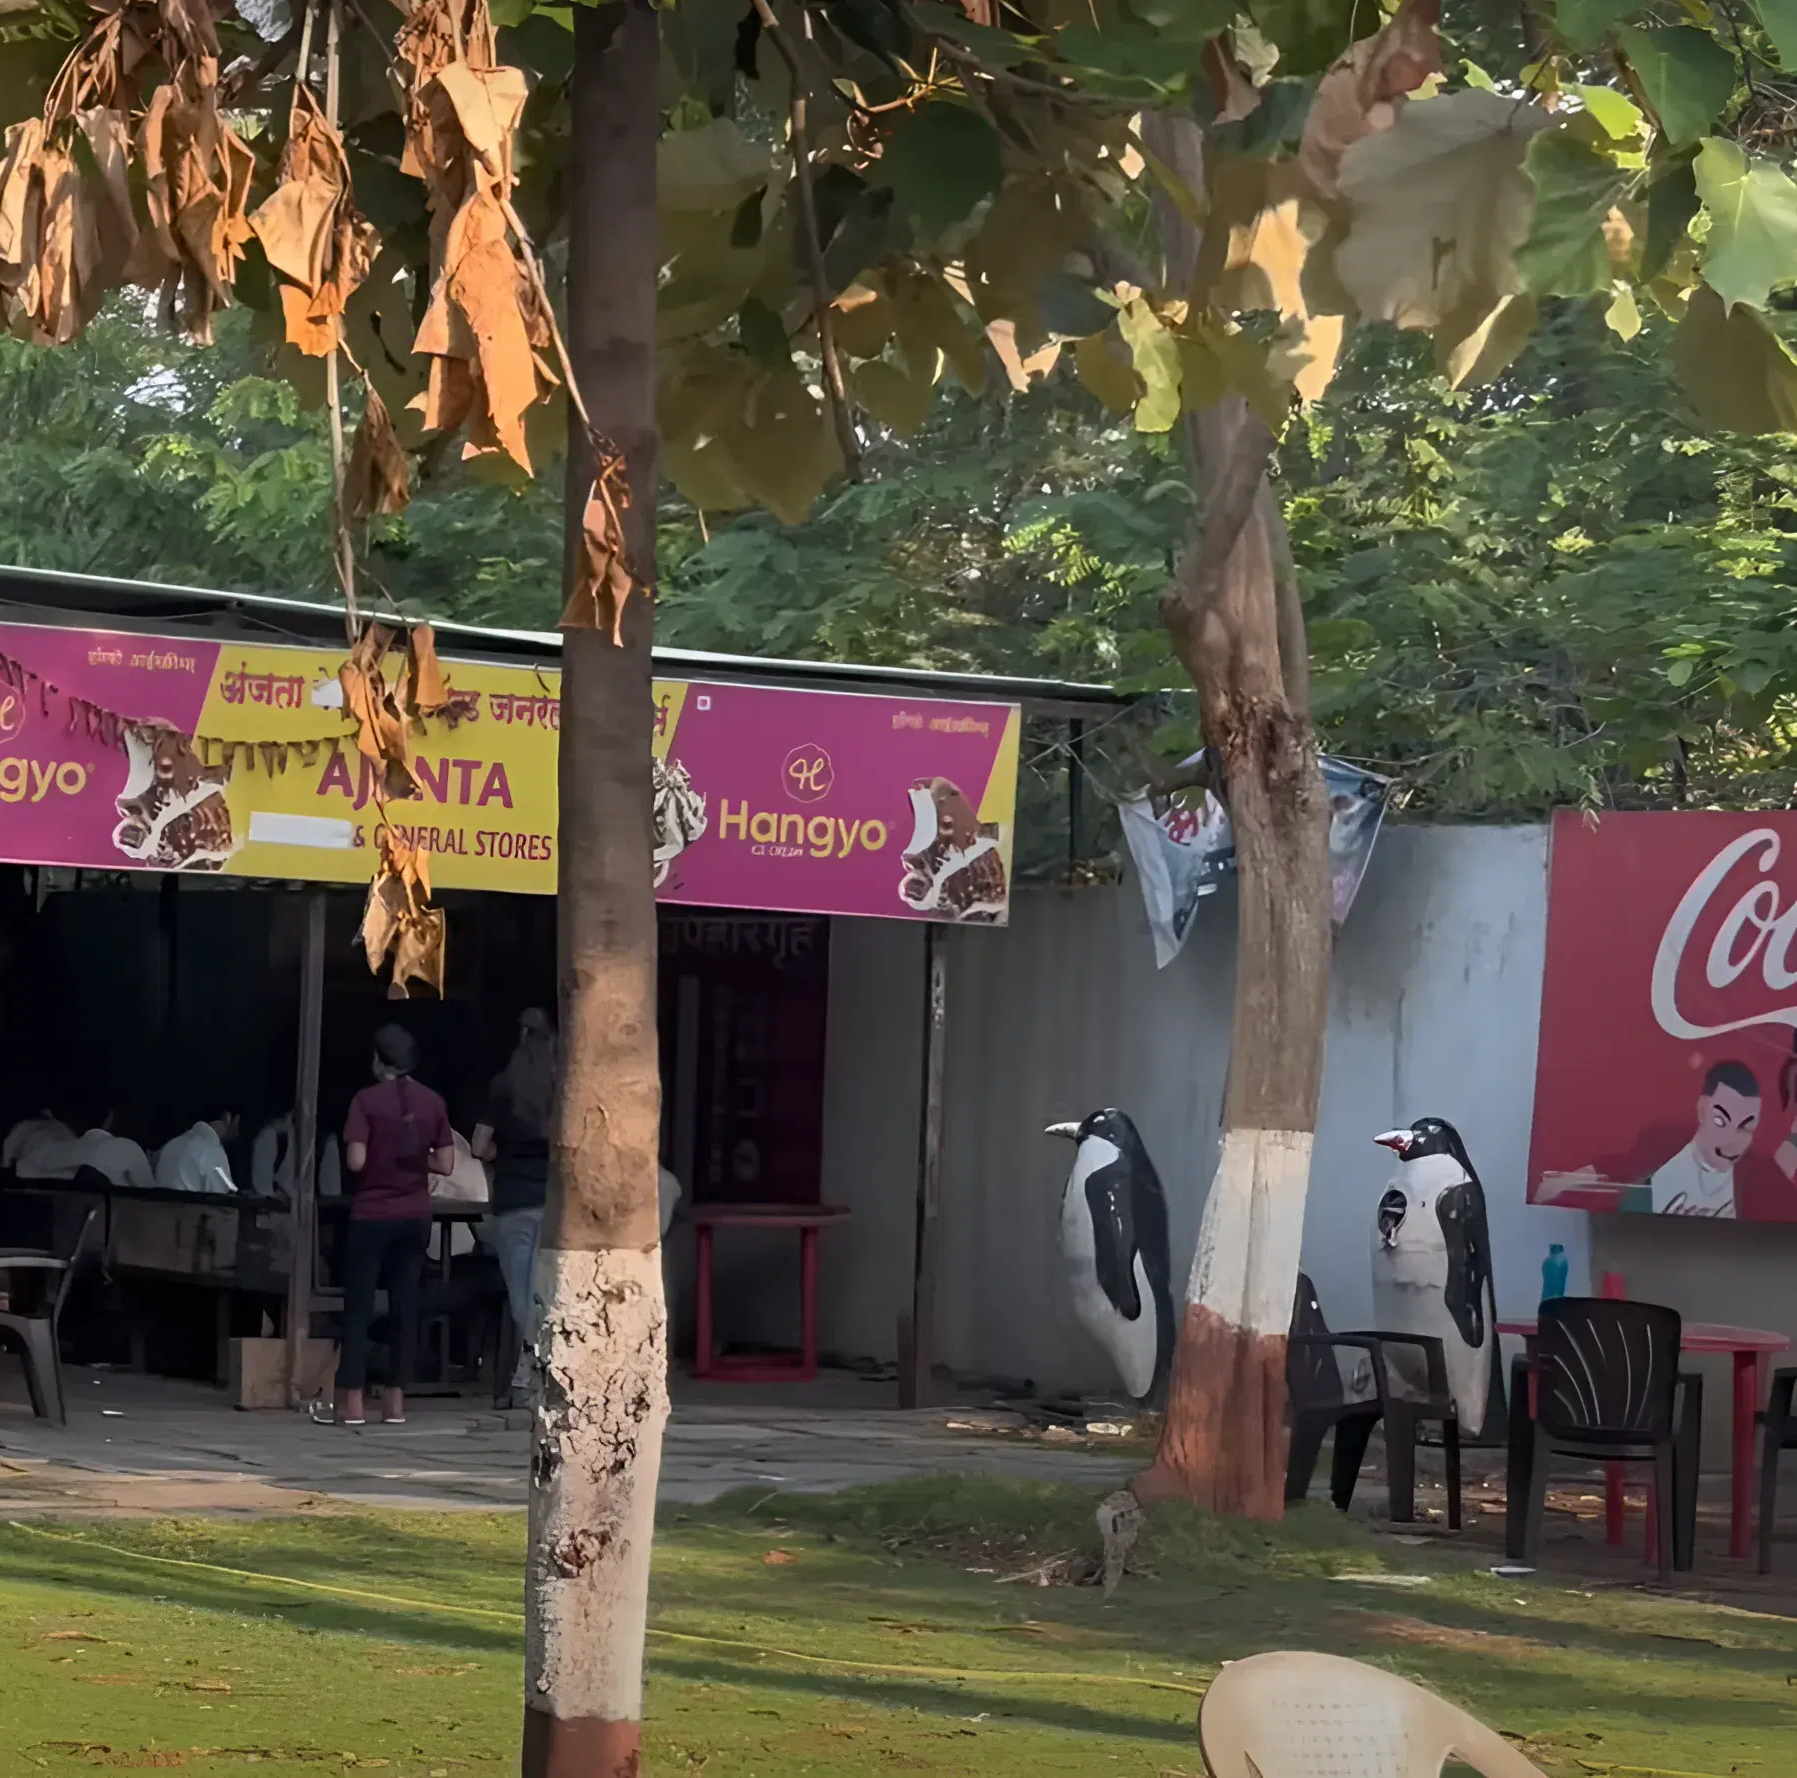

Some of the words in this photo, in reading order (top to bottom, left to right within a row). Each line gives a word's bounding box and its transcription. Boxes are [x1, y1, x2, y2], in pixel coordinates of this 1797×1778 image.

[219, 661, 305, 709] अंजता
[316, 752, 514, 811] AJNTA
[474, 830, 553, 861] STORES
[719, 798, 888, 860] Hangyo
